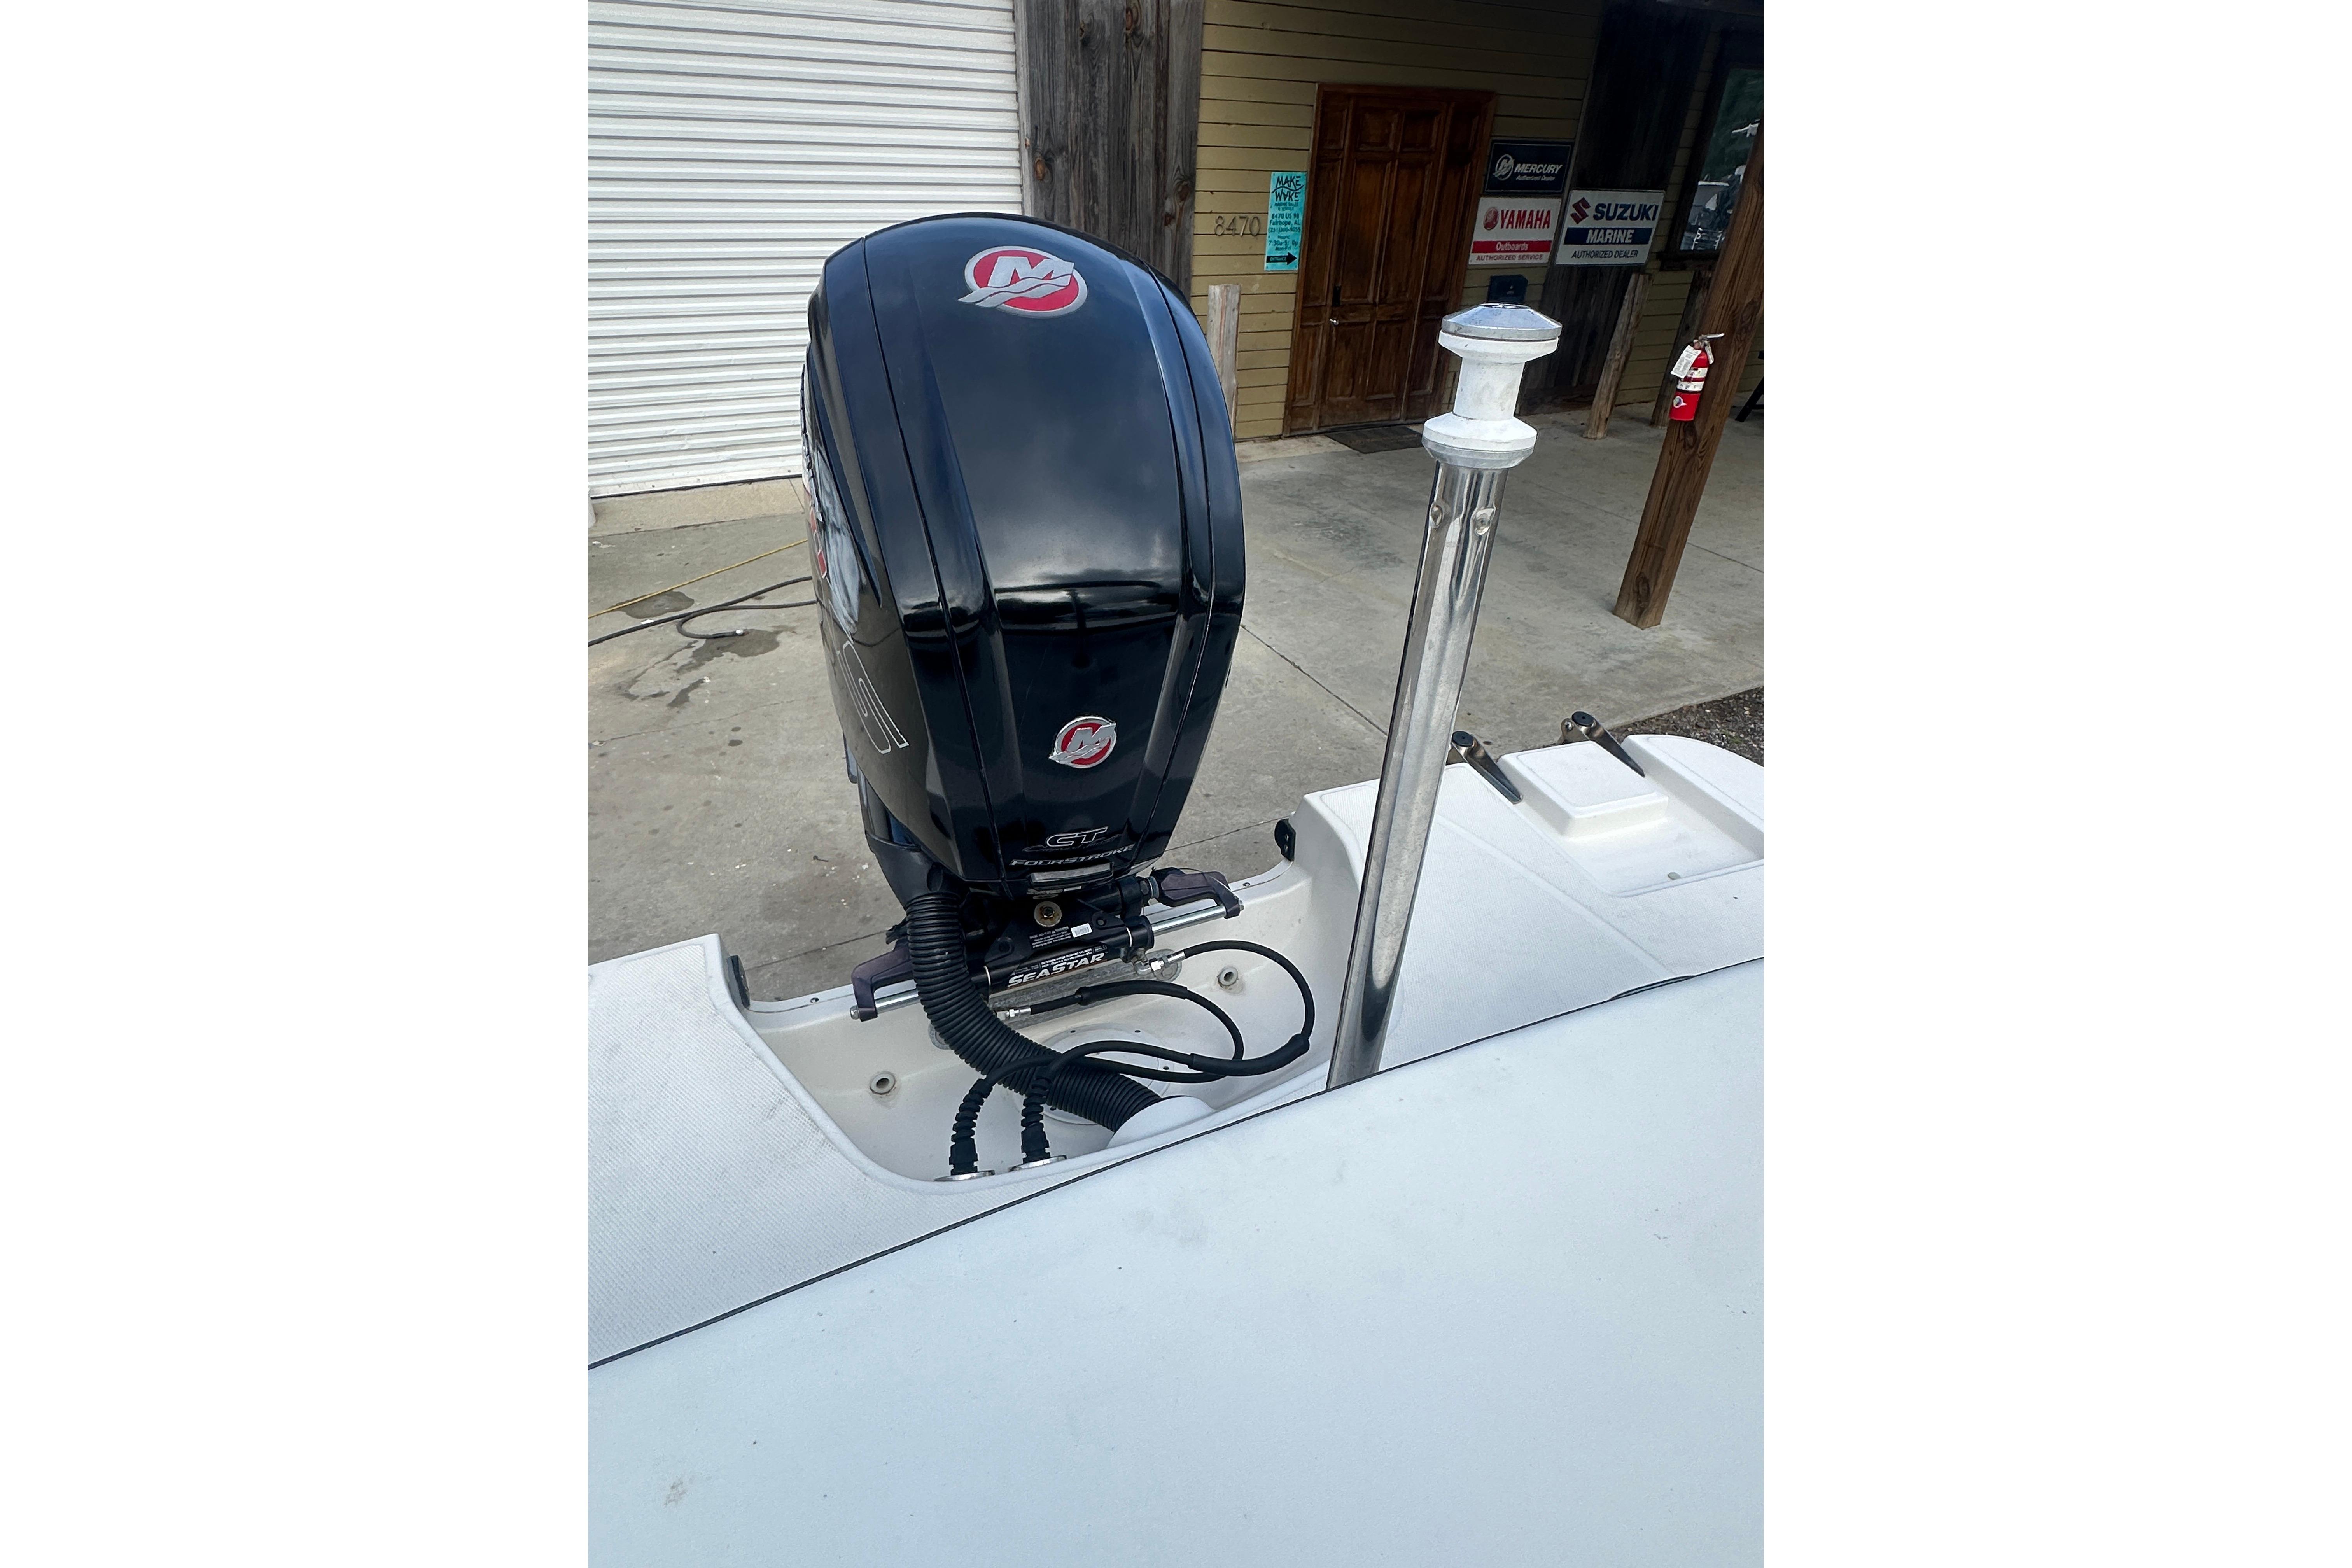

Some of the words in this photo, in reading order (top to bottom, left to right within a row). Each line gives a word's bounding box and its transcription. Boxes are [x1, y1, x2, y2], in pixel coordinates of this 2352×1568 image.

[1514, 163, 1563, 173] MERCURY
[1276, 175, 1301, 189] MAKE
[1275, 188, 1301, 201] WAKE
[1593, 203, 1659, 220] SUZUKI
[1500, 209, 1551, 229] YAMAHA
[1214, 216, 1261, 237] 8470
[1586, 229, 1635, 243] MARINE
[1496, 242, 1529, 251] Outboards
[1614, 250, 1638, 258] DEALER
[1009, 844, 1136, 866] FOURSTROKE
